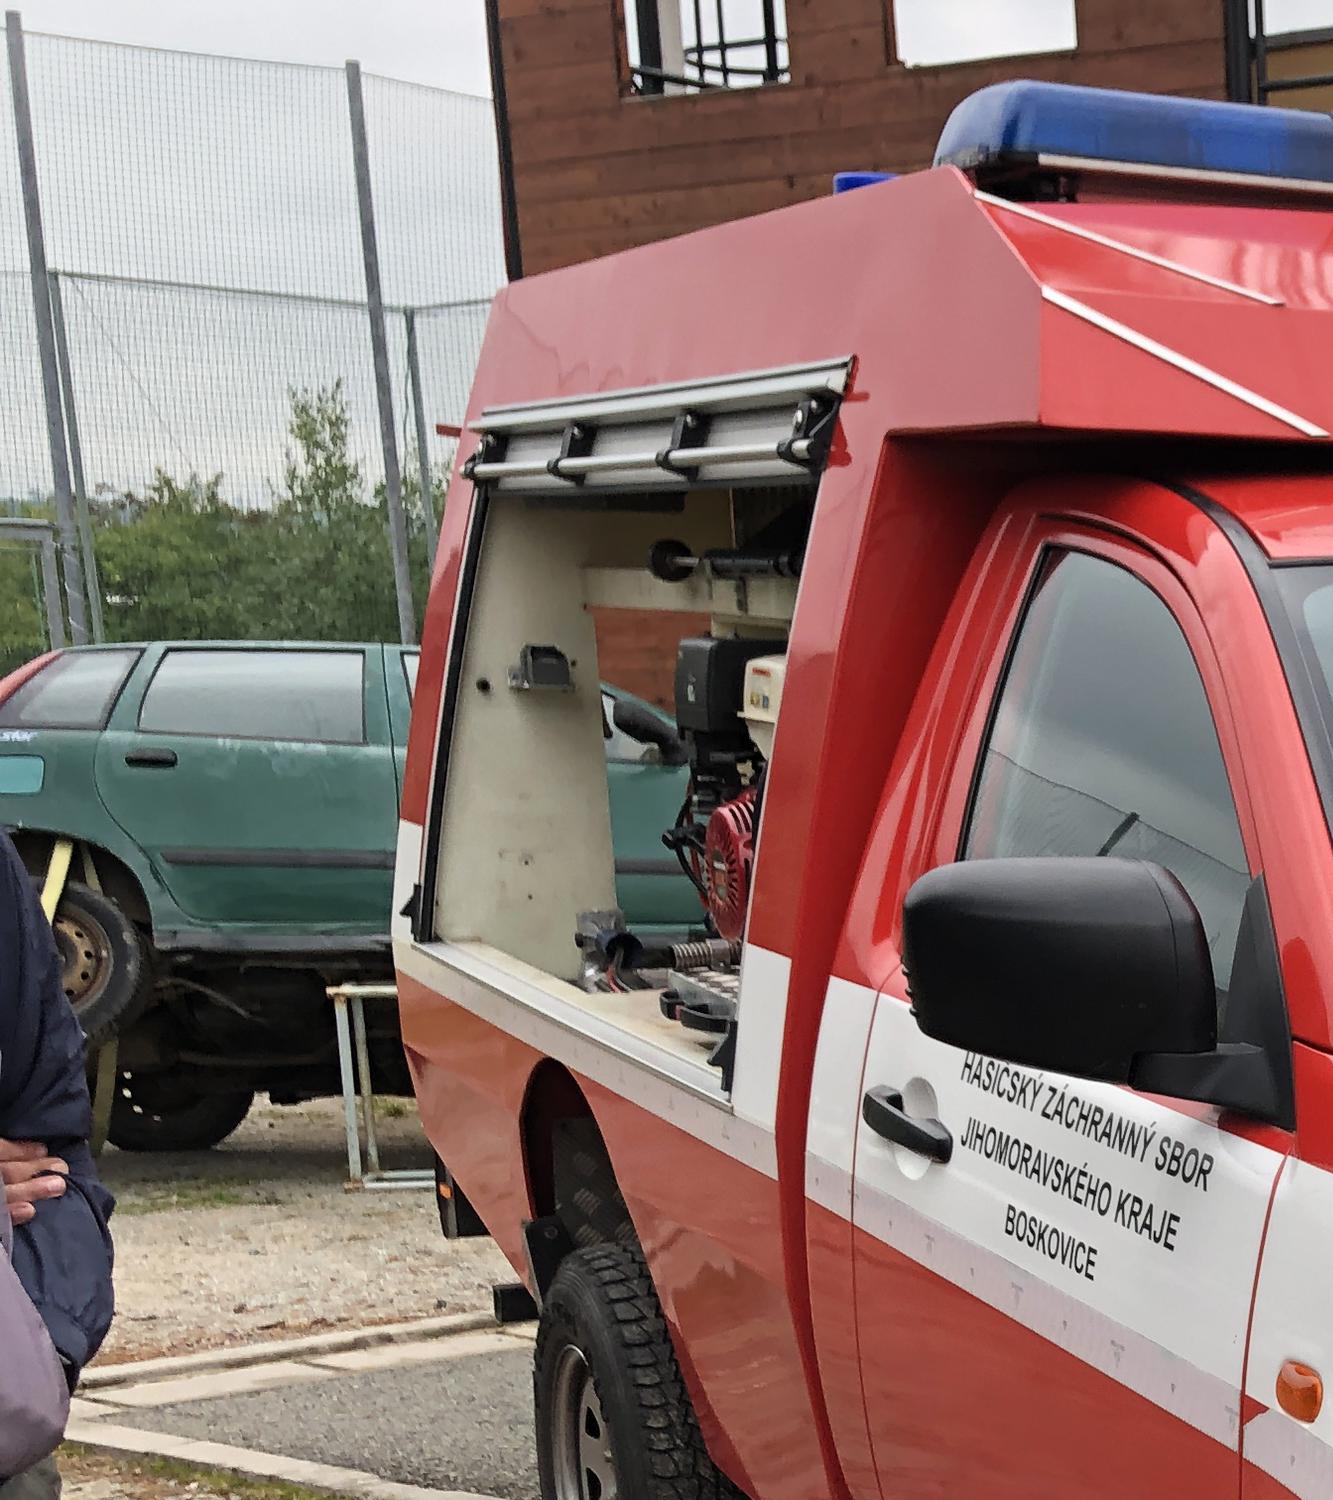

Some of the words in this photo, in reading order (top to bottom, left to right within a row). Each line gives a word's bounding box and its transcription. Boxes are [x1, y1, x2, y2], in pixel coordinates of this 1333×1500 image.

[960, 1050, 1043, 1112] HASIČSKÝ
[1041, 1083, 1157, 1163] ZÁCHRANNÝ
[1154, 1135, 1215, 1192] SBOR
[960, 1116, 1113, 1217] JIHOMORAVSKÉHO
[1113, 1188, 1182, 1252] KRAJE
[1004, 1203, 1098, 1282] BOSKOVICE
